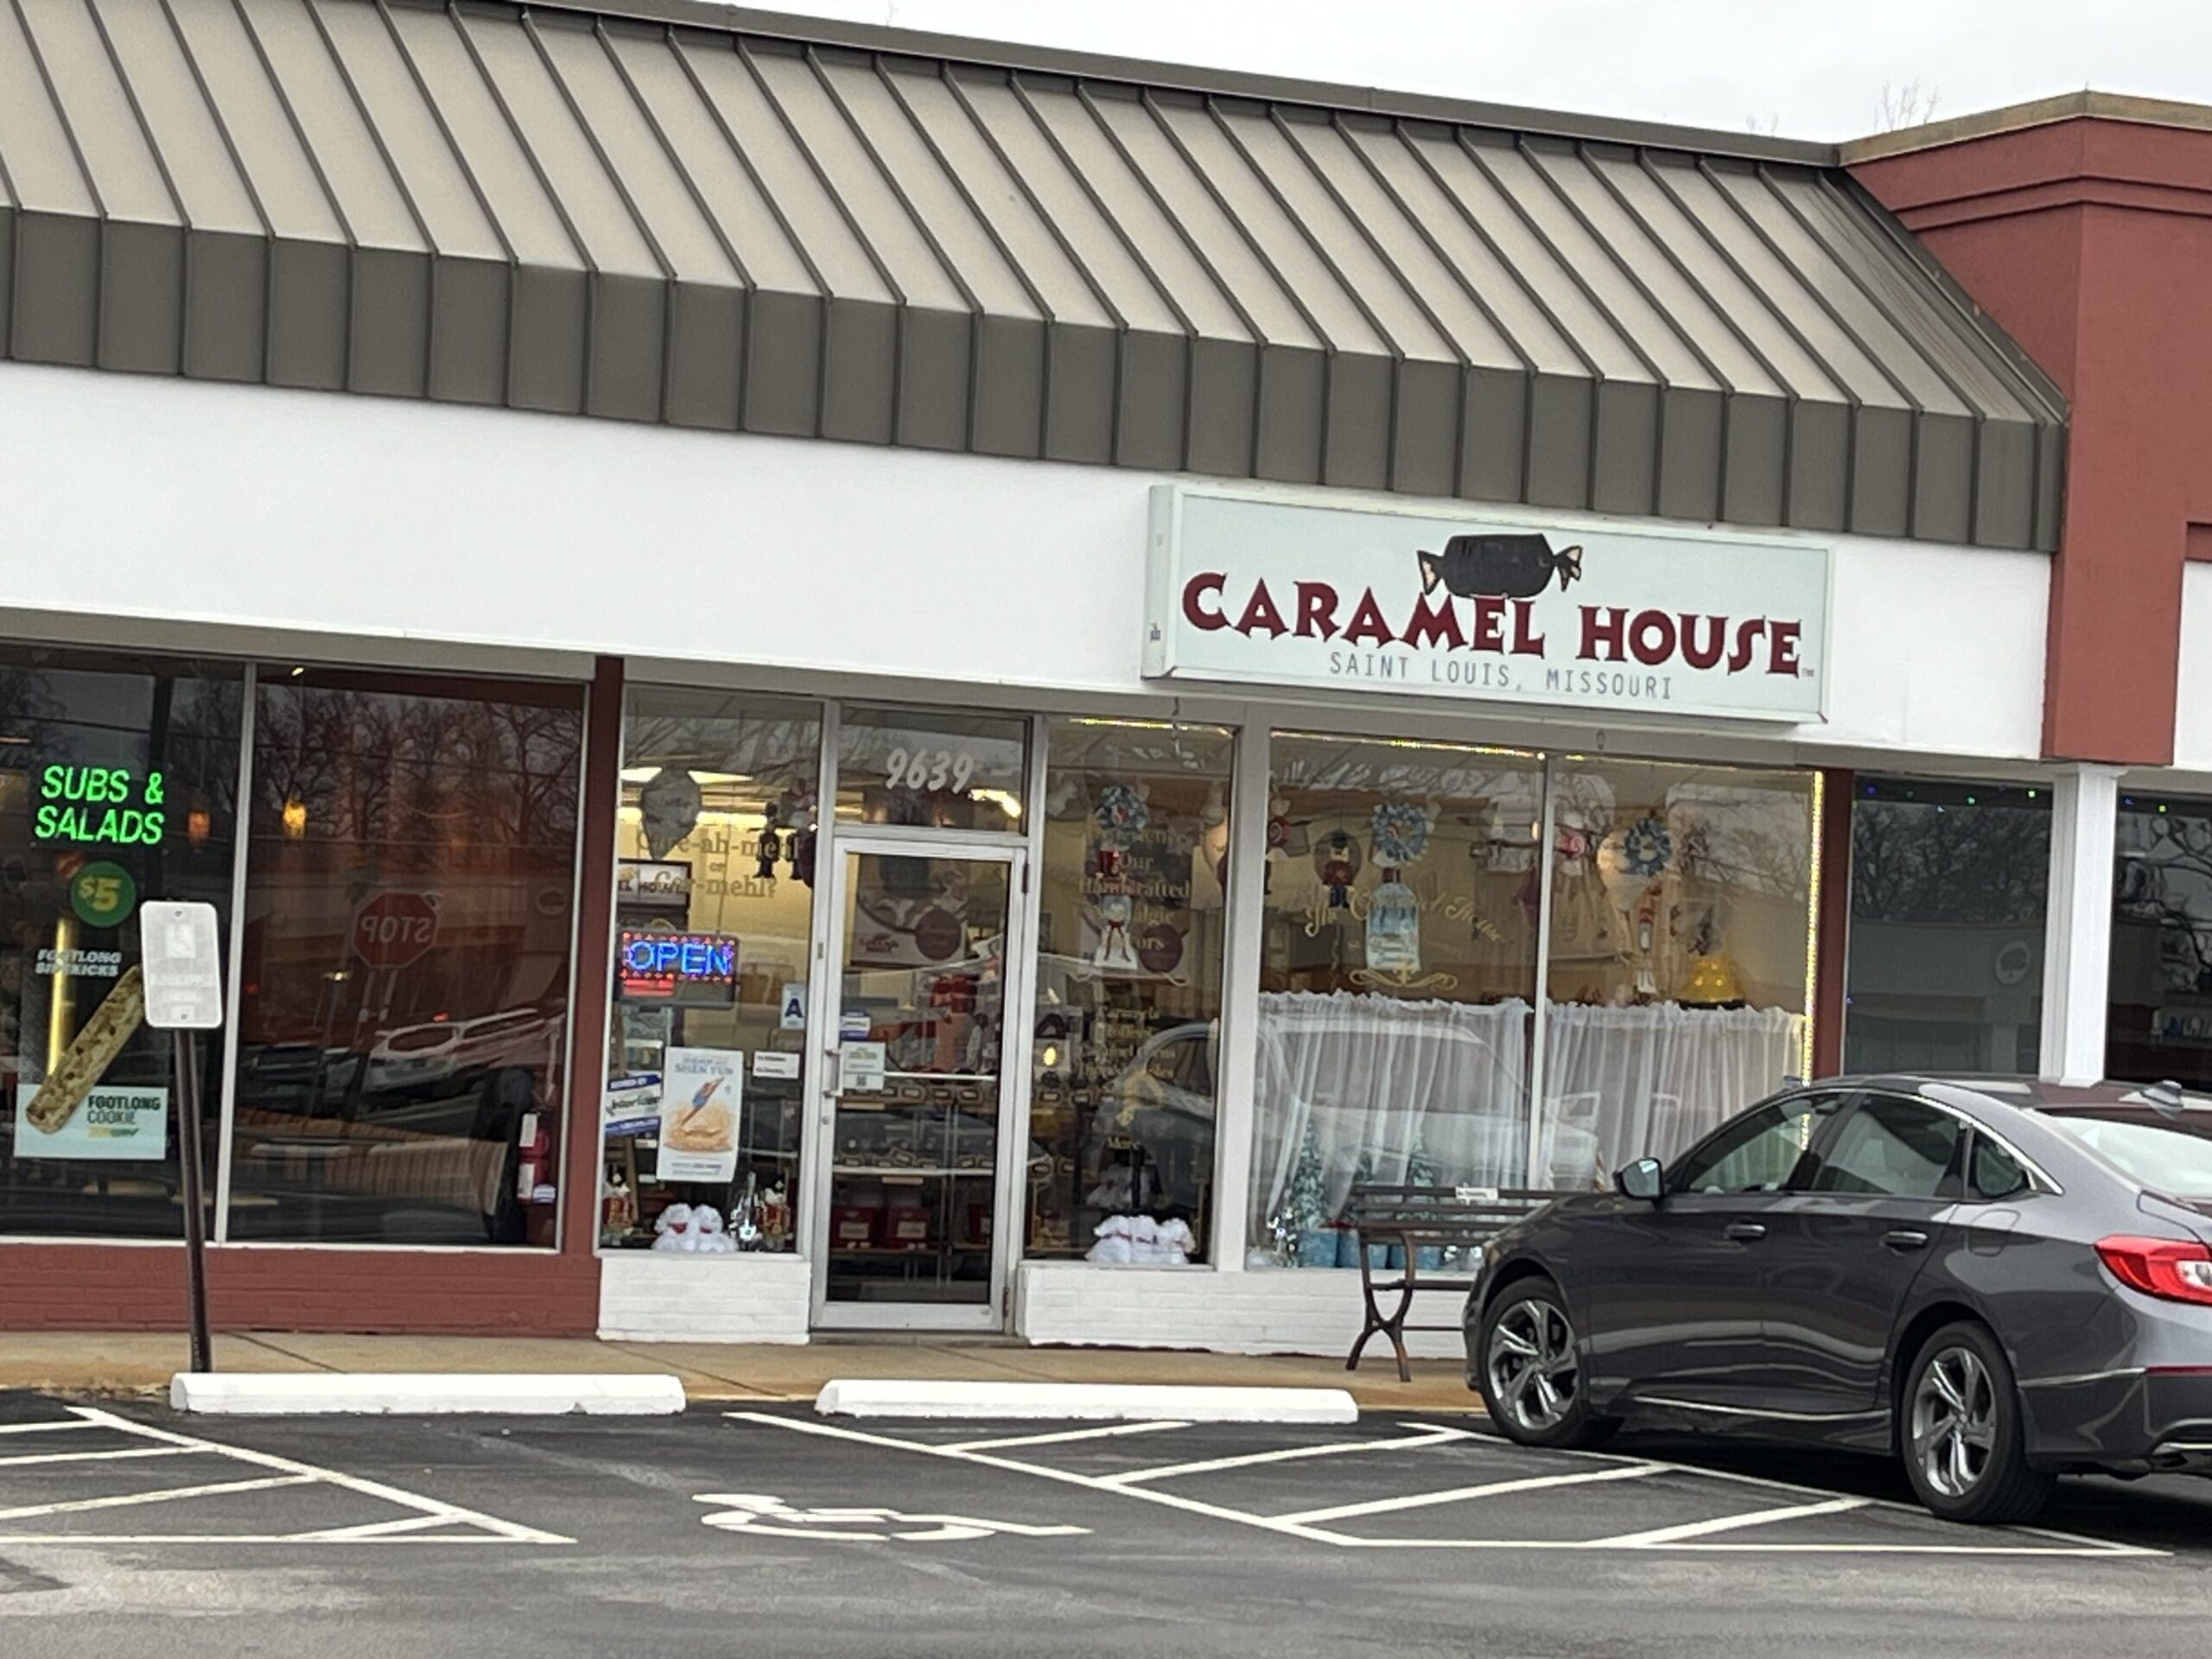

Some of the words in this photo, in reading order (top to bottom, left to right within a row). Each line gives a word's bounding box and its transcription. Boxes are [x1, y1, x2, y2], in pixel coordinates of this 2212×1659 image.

[1182, 571, 1546, 659] CARAMEL
[1575, 604, 1802, 678] HOUSE
[1330, 652, 1409, 679] SAINT
[1431, 658, 1522, 691] LOUIS,
[1546, 668, 1671, 700] MISSOURI
[41, 766, 130, 803] SUBS
[144, 772, 163, 804] &
[886, 747, 974, 794] 9639
[35, 805, 165, 844] SALADS
[79, 876, 121, 912] $5
[35, 962, 118, 976] SIKICKS
[629, 941, 733, 976] OPEN
[785, 997, 804, 1019] A
[88, 1095, 161, 1110] FOOTLONG
